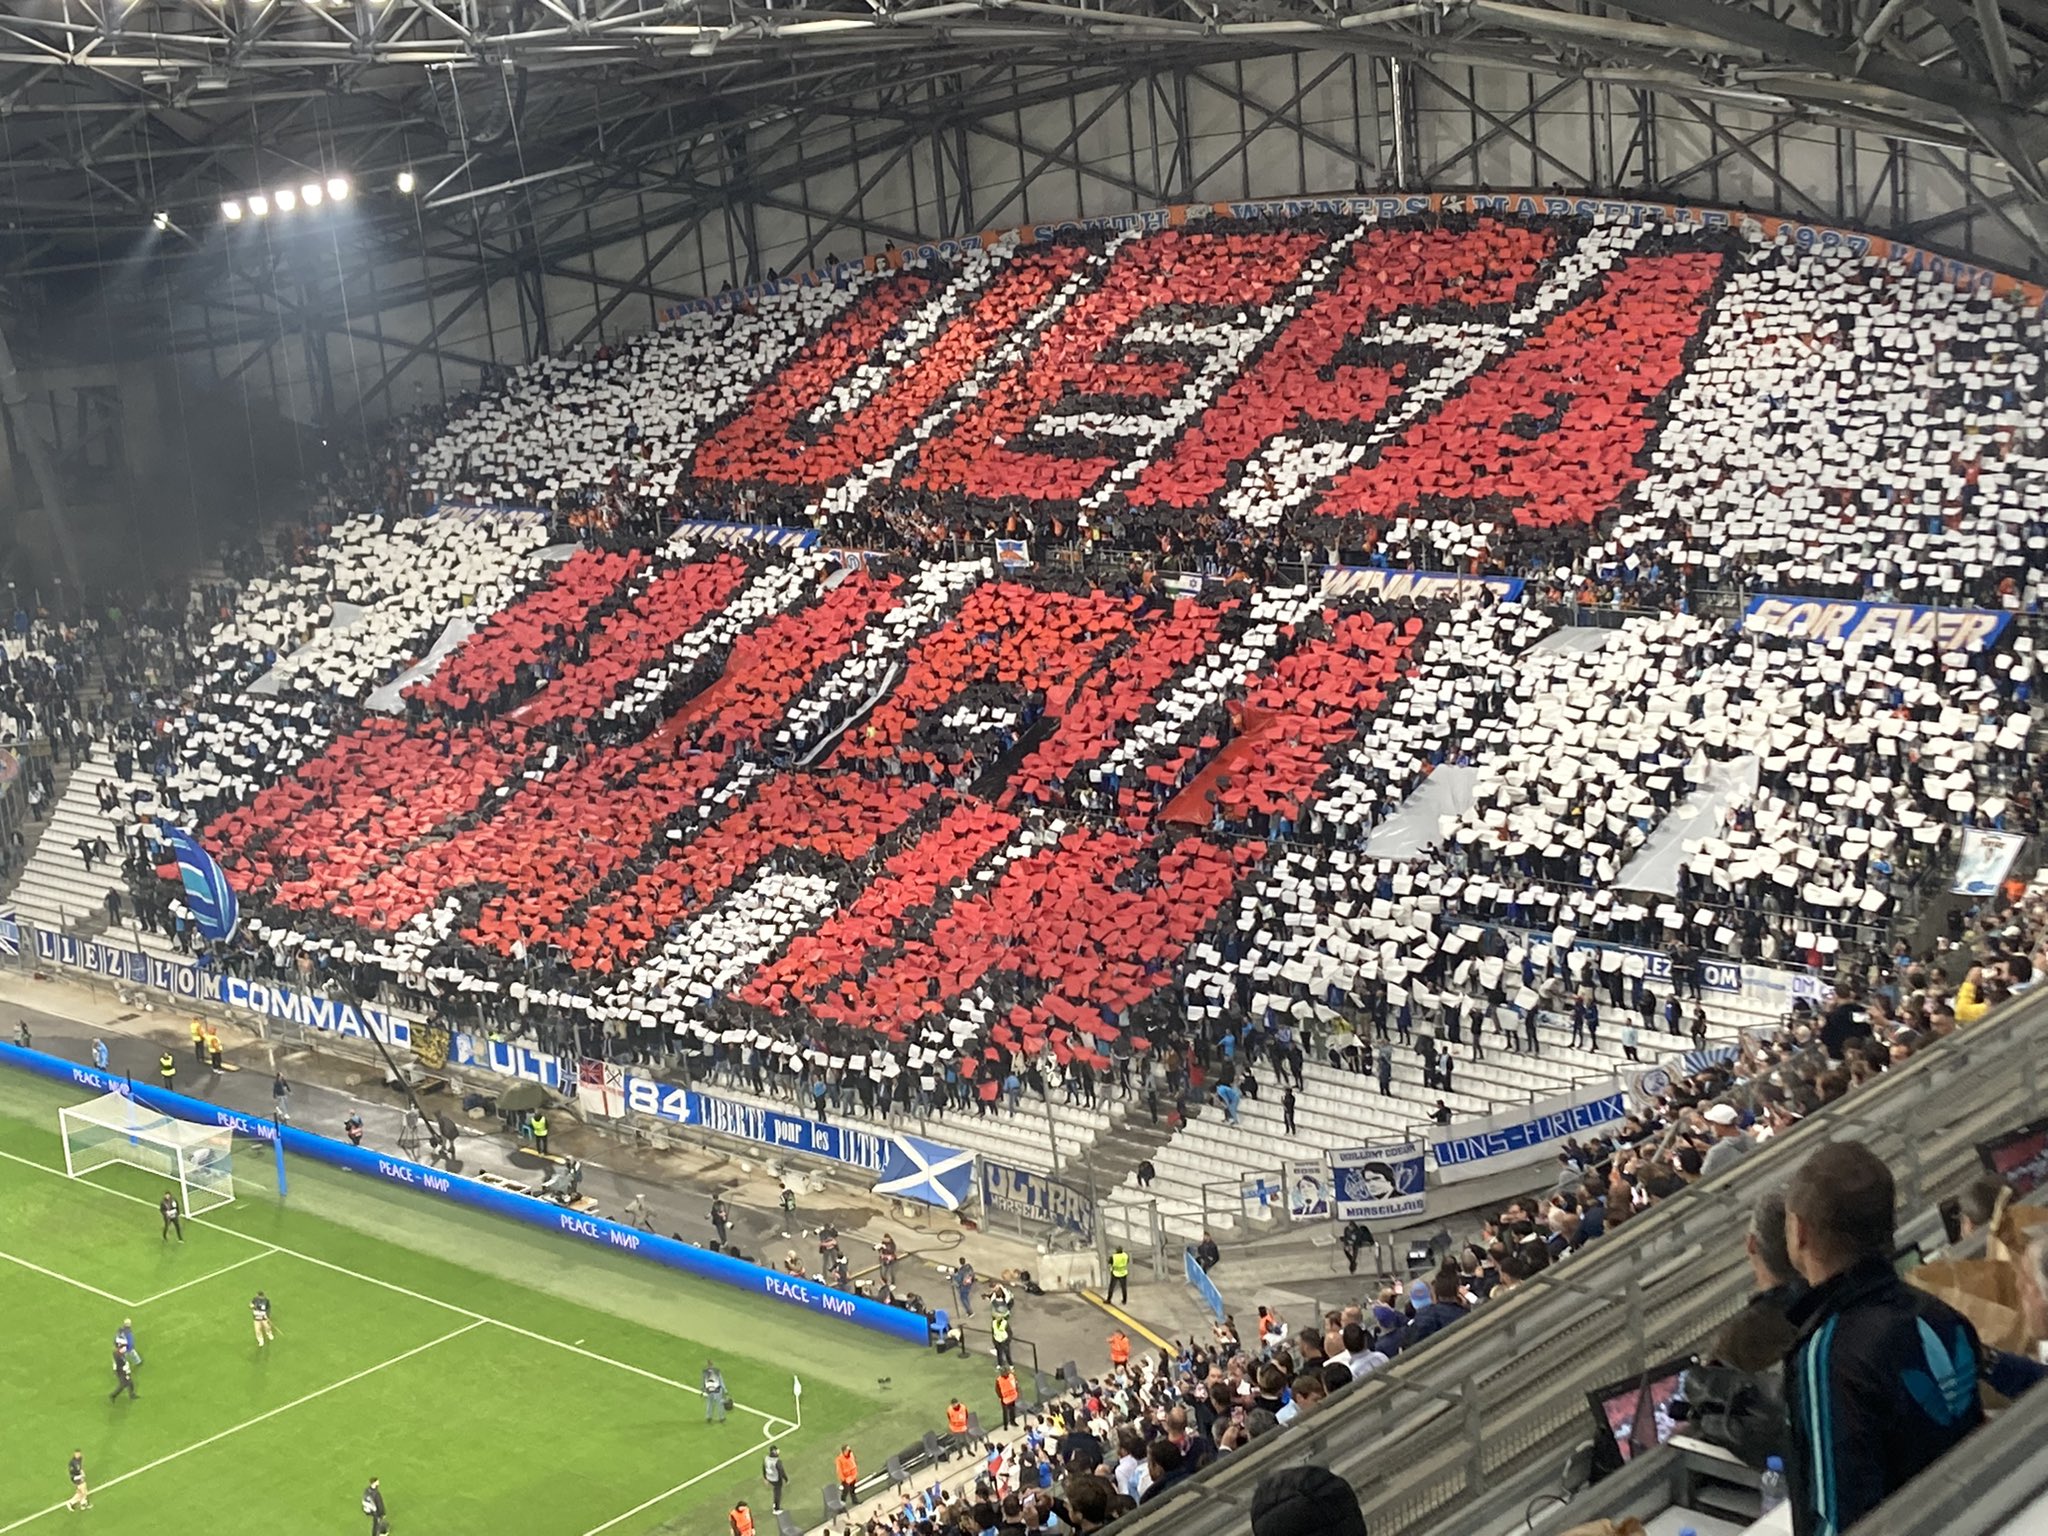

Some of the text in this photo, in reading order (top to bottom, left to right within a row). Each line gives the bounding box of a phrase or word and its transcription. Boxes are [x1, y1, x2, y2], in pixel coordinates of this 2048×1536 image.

[1032, 208, 1170, 242] SOUTH
[1229, 196, 1430, 219] WINNERS
[1472, 196, 1730, 233] MARSEILLE
[688, 216, 1726, 532] UEFA
[1742, 599, 1999, 650] FOR EVER
[154, 960, 222, 1000] L'OM
[1703, 965, 1739, 988] OM
[226, 976, 412, 1050] COMMAND
[72, 1067, 102, 1088] PEACE
[488, 1039, 557, 1085] ULT
[628, 1077, 691, 1123] 84
[216, 1111, 250, 1134] PEACE
[700, 1095, 891, 1172] LIBERTE pour les ULTRA
[378, 1159, 450, 1193] PEACE МИР
[1346, 1199, 1424, 1218] MARSEILLAIS
[560, 1213, 640, 1250] PEACE МИР
[765, 1275, 856, 1317] PEACE МИР
